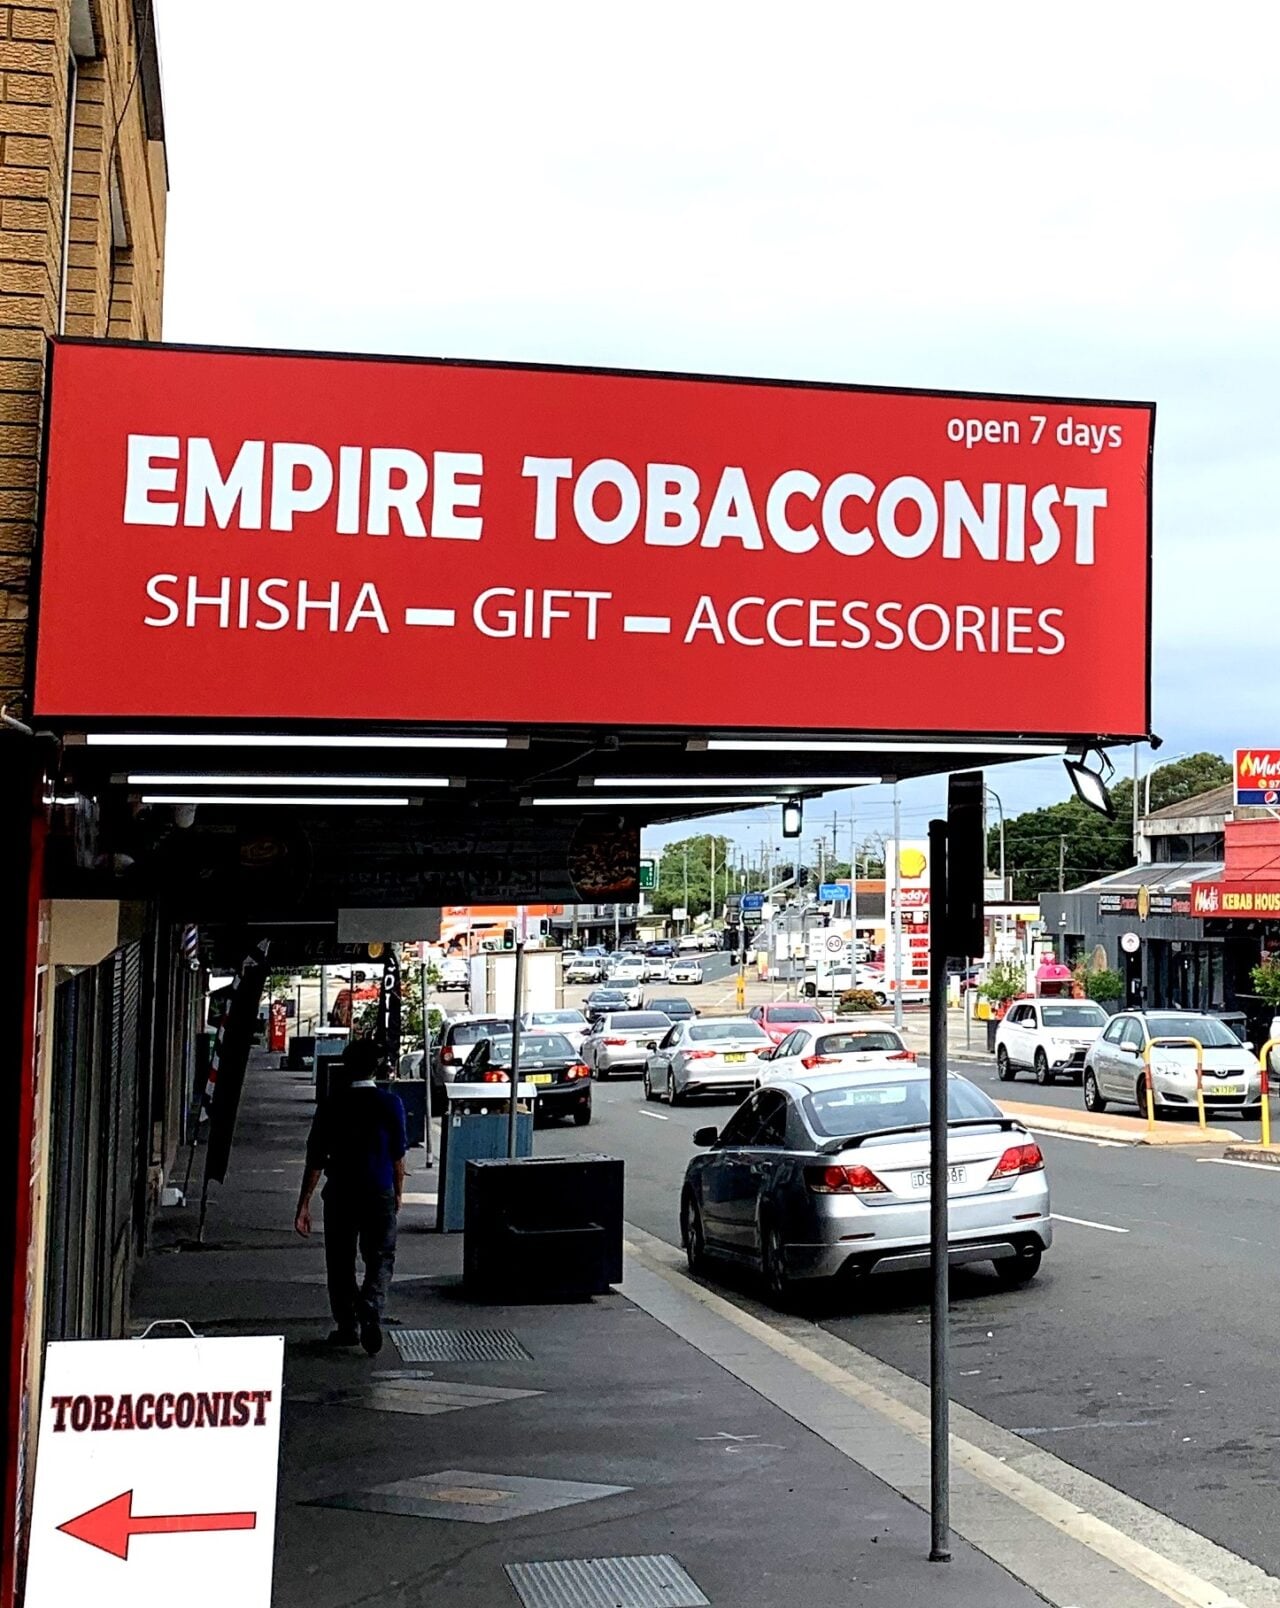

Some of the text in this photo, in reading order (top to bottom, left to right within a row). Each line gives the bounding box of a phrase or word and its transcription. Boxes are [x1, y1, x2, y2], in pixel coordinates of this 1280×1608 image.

[947, 415, 1122, 454] open 7 days
[123, 433, 1108, 566] EMPIRE TOBACCONIST
[144, 573, 390, 634] SHISHA
[472, 587, 612, 641] GIFT
[684, 595, 1066, 655] ACCESSORIES
[1222, 893, 1252, 910] KEBAB
[51, 1390, 272, 1432] TOBACCONIST
